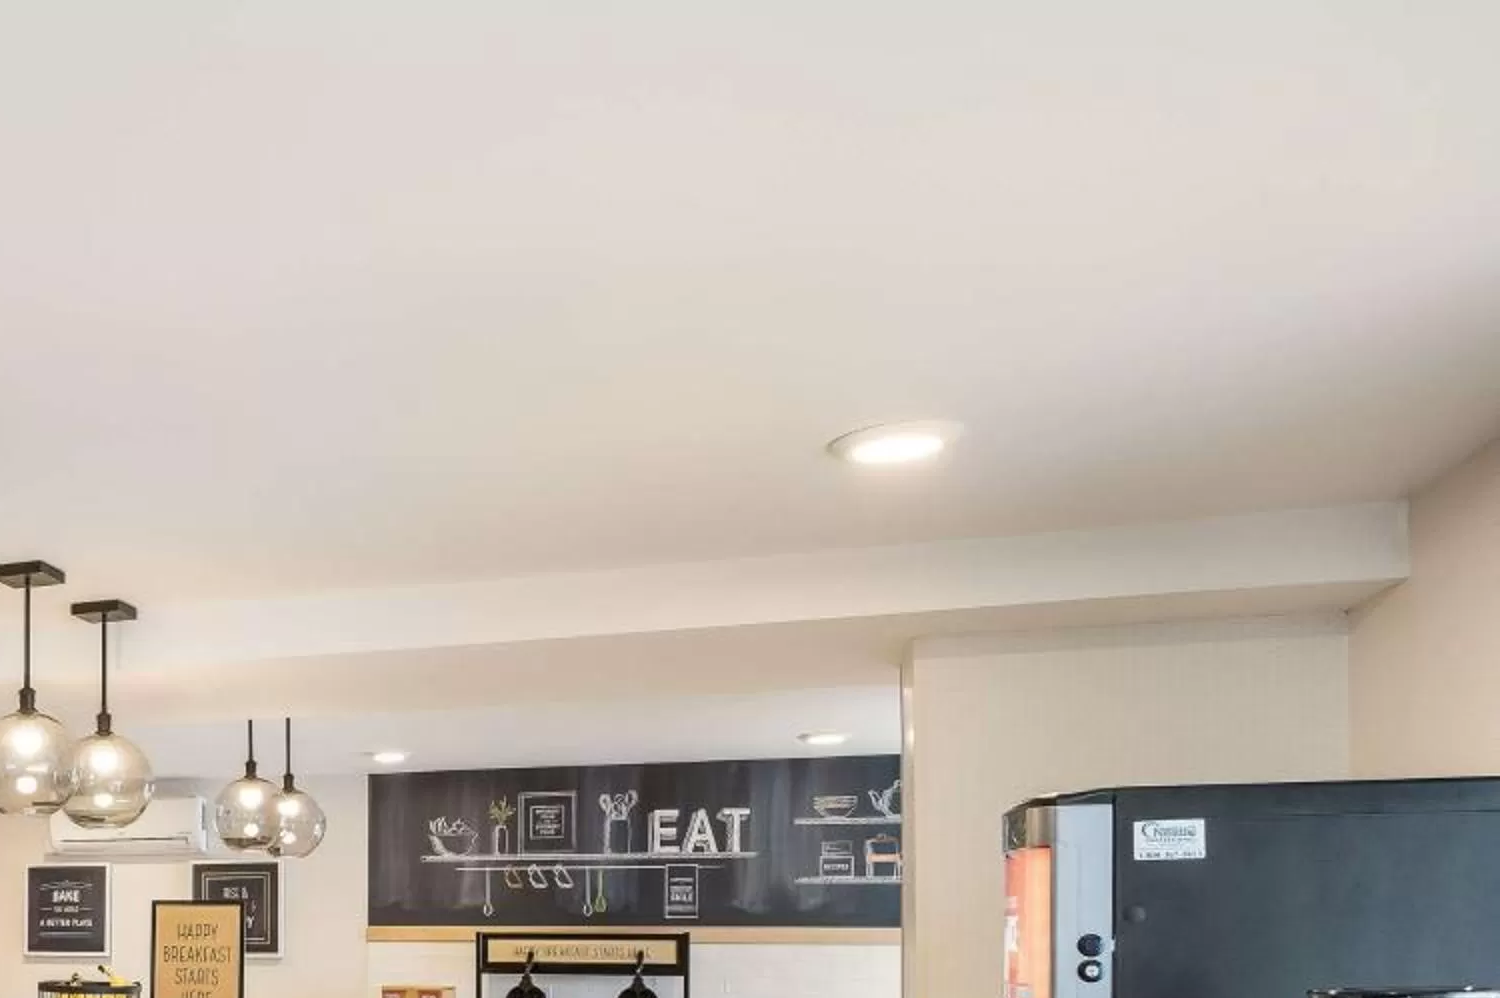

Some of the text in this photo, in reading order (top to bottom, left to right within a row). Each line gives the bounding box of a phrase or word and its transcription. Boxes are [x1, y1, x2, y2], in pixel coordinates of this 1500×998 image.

[647, 807, 751, 854] EAT
[52, 889, 81, 903] BAKE
[177, 923, 219, 940] HAPPY
[163, 944, 233, 964] BREAKFAST
[175, 967, 220, 986] STARTS
